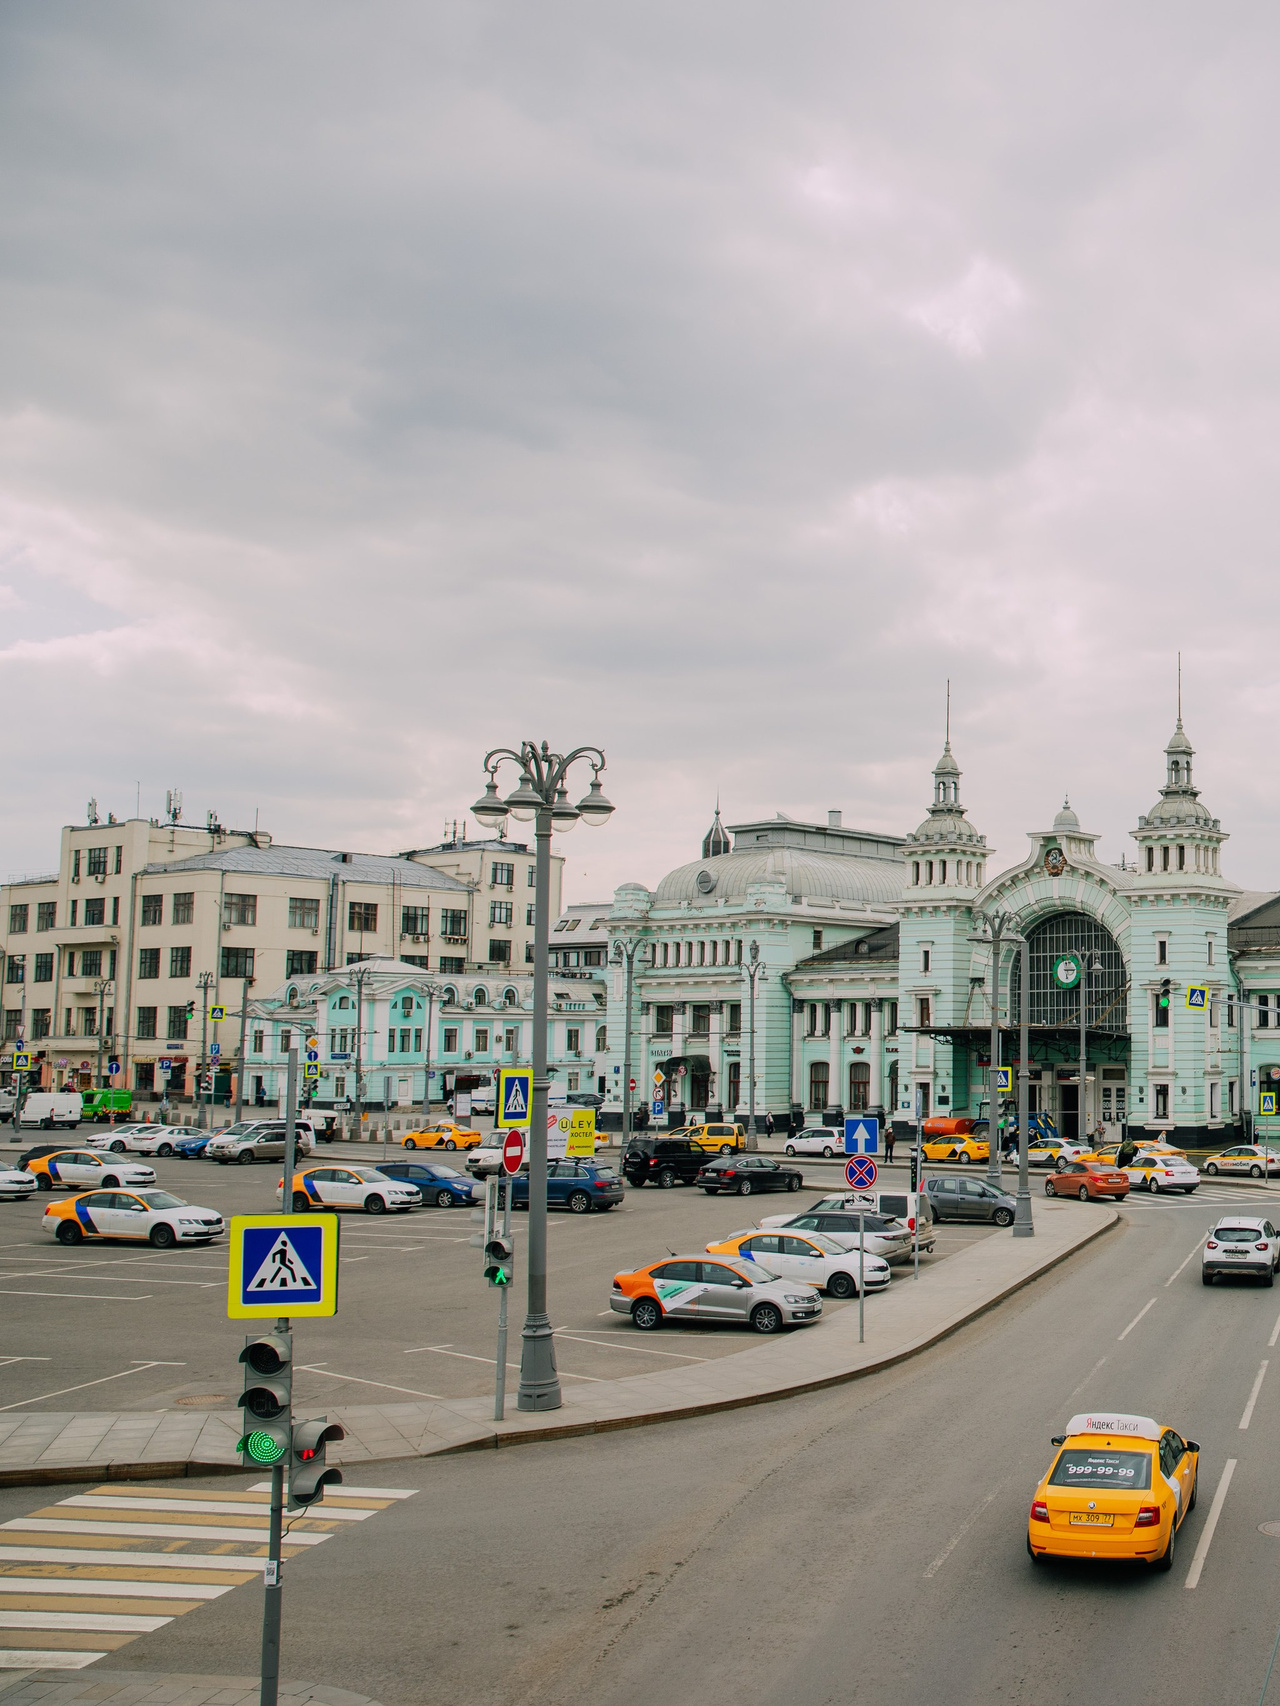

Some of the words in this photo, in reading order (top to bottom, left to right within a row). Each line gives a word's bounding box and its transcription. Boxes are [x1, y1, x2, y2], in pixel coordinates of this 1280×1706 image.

[1086, 1418, 1114, 1431] Яндекс
[1117, 1420, 1139, 1431] Такси
[1068, 1466, 1134, 1476] 999-99-99
